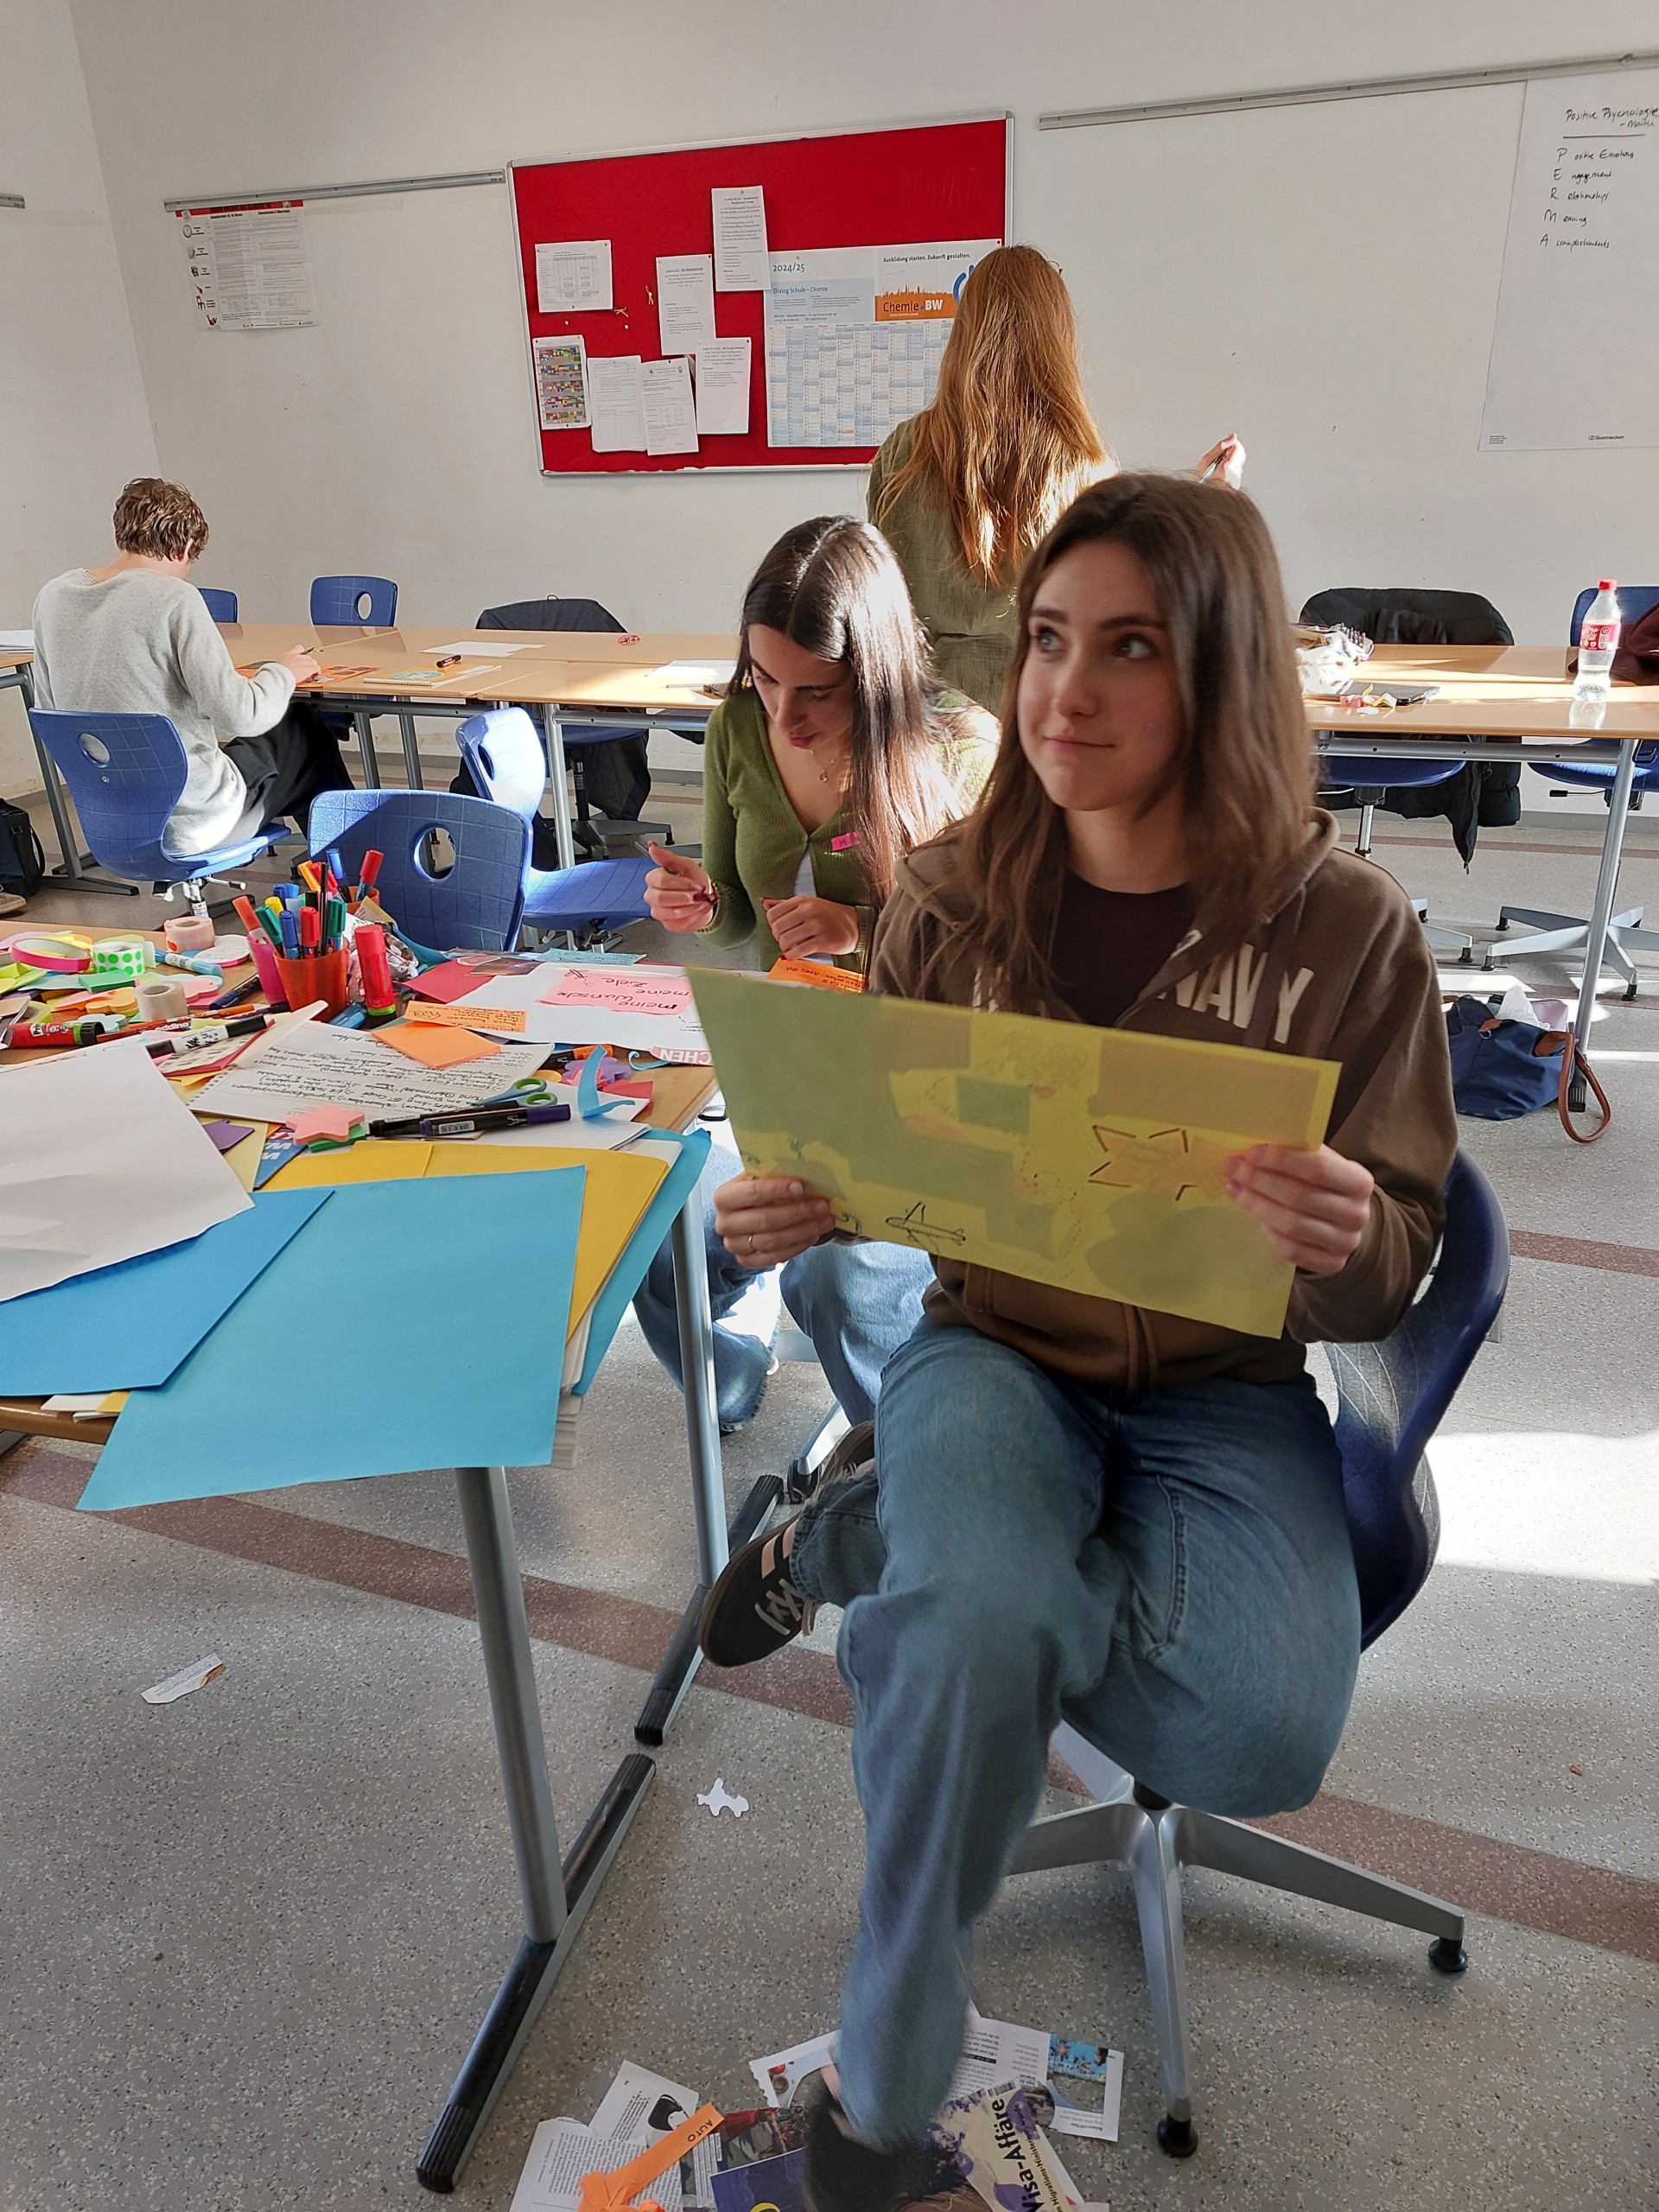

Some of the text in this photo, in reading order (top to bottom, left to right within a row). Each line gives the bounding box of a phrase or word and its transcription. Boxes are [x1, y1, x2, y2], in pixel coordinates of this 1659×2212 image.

[1566, 109, 1599, 122] Positive
[1556, 147, 1567, 162] P
[1553, 168, 1563, 181] E
[1549, 187, 1560, 200] R
[1543, 208, 1557, 223] M
[1540, 232, 1548, 248] A
[946, 252, 971, 261] gestalten.
[772, 262, 805, 274] 2024/25
[772, 287, 790, 296] Dialog
[619, 1001, 678, 1010] meine
[687, 2119, 713, 2142] AUTO
